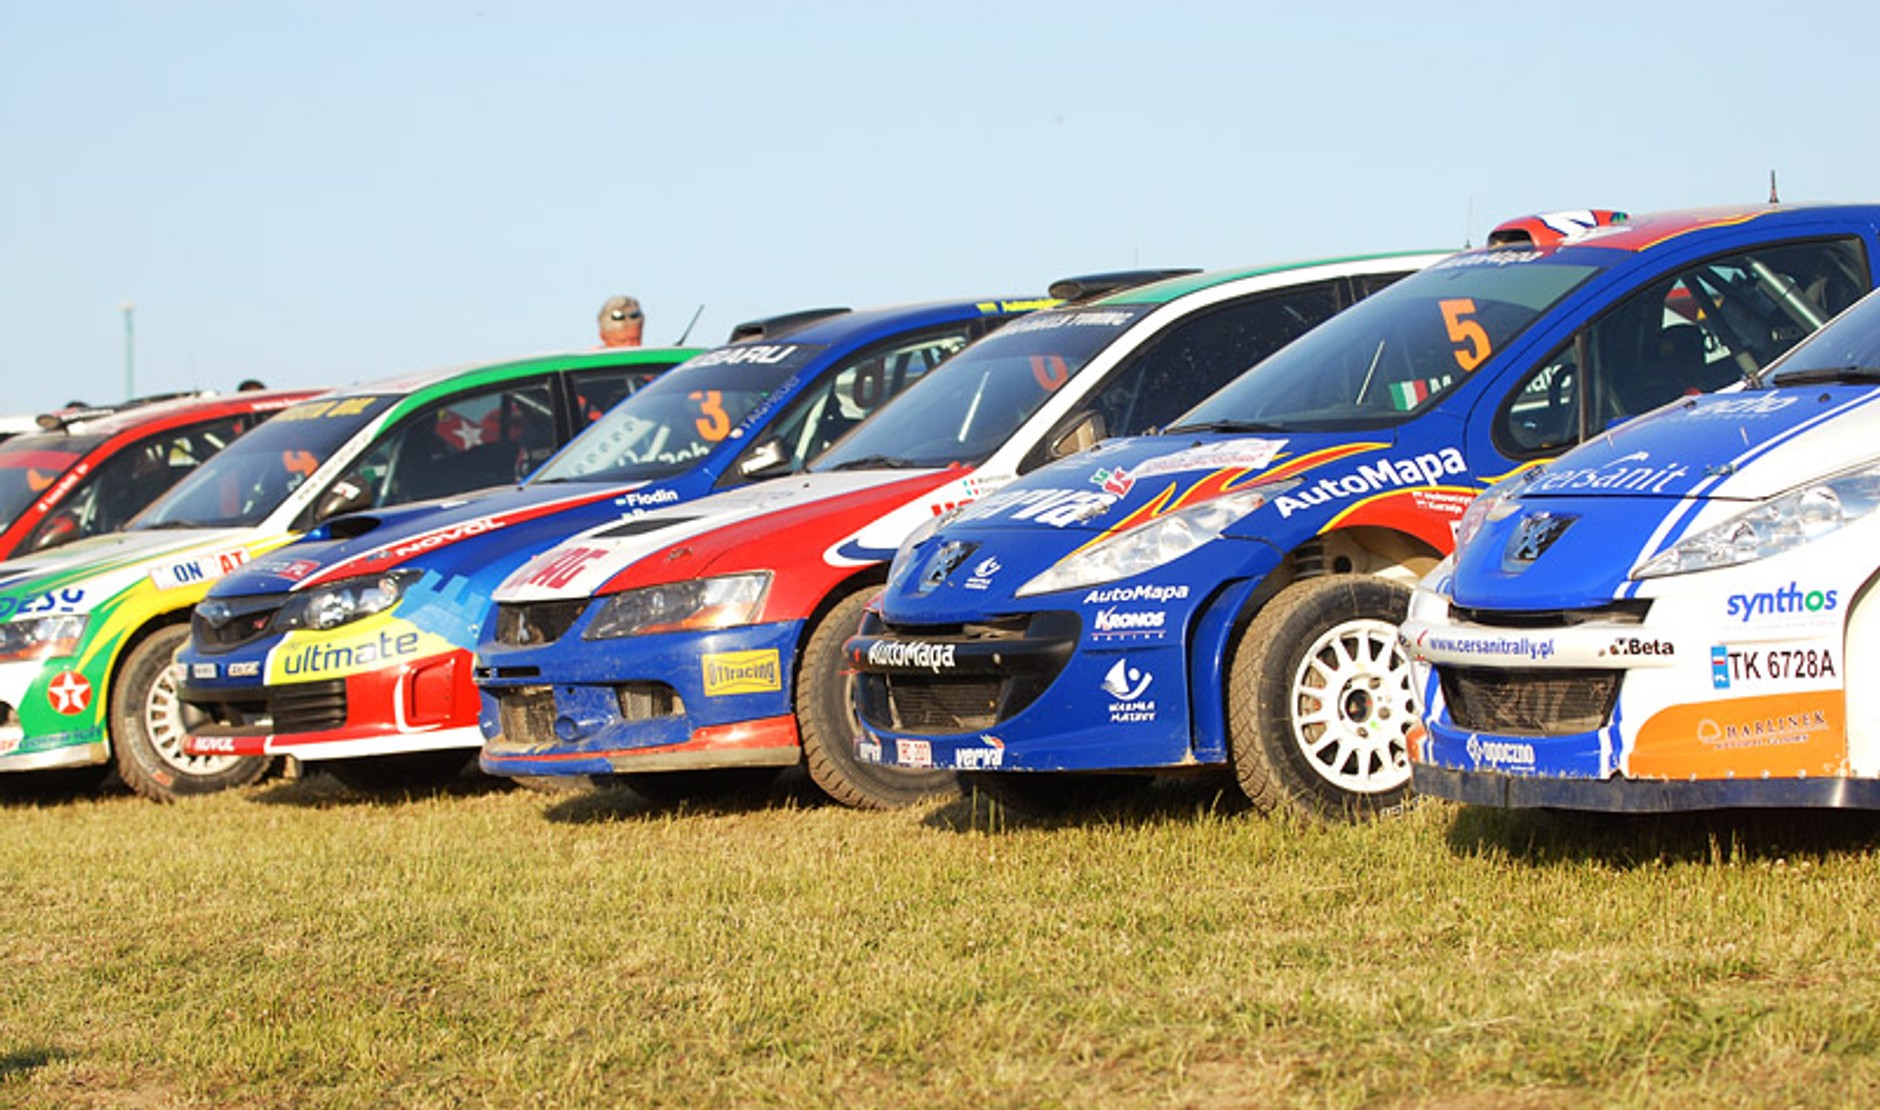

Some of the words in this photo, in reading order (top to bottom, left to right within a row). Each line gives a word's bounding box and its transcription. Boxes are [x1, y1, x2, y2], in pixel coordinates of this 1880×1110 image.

[1438, 298, 1493, 373] 5
[688, 389, 731, 442] 3
[625, 488, 679, 507] Flodin
[1273, 446, 1468, 519] AutoMapa
[395, 517, 506, 557] NOVOL
[1083, 584, 1191, 604] AutoMapa
[1726, 580, 1838, 623] synthos
[1094, 604, 1166, 631] KRONOS
[285, 631, 419, 675] ultimate
[867, 639, 957, 674] AutoMapa
[1429, 636, 1556, 660] www.cersanitrally.pl
[1628, 638, 1676, 656] Beta
[1727, 651, 1762, 681] TK
[1766, 648, 1837, 680] 6728A
[954, 746, 1005, 769] verva
